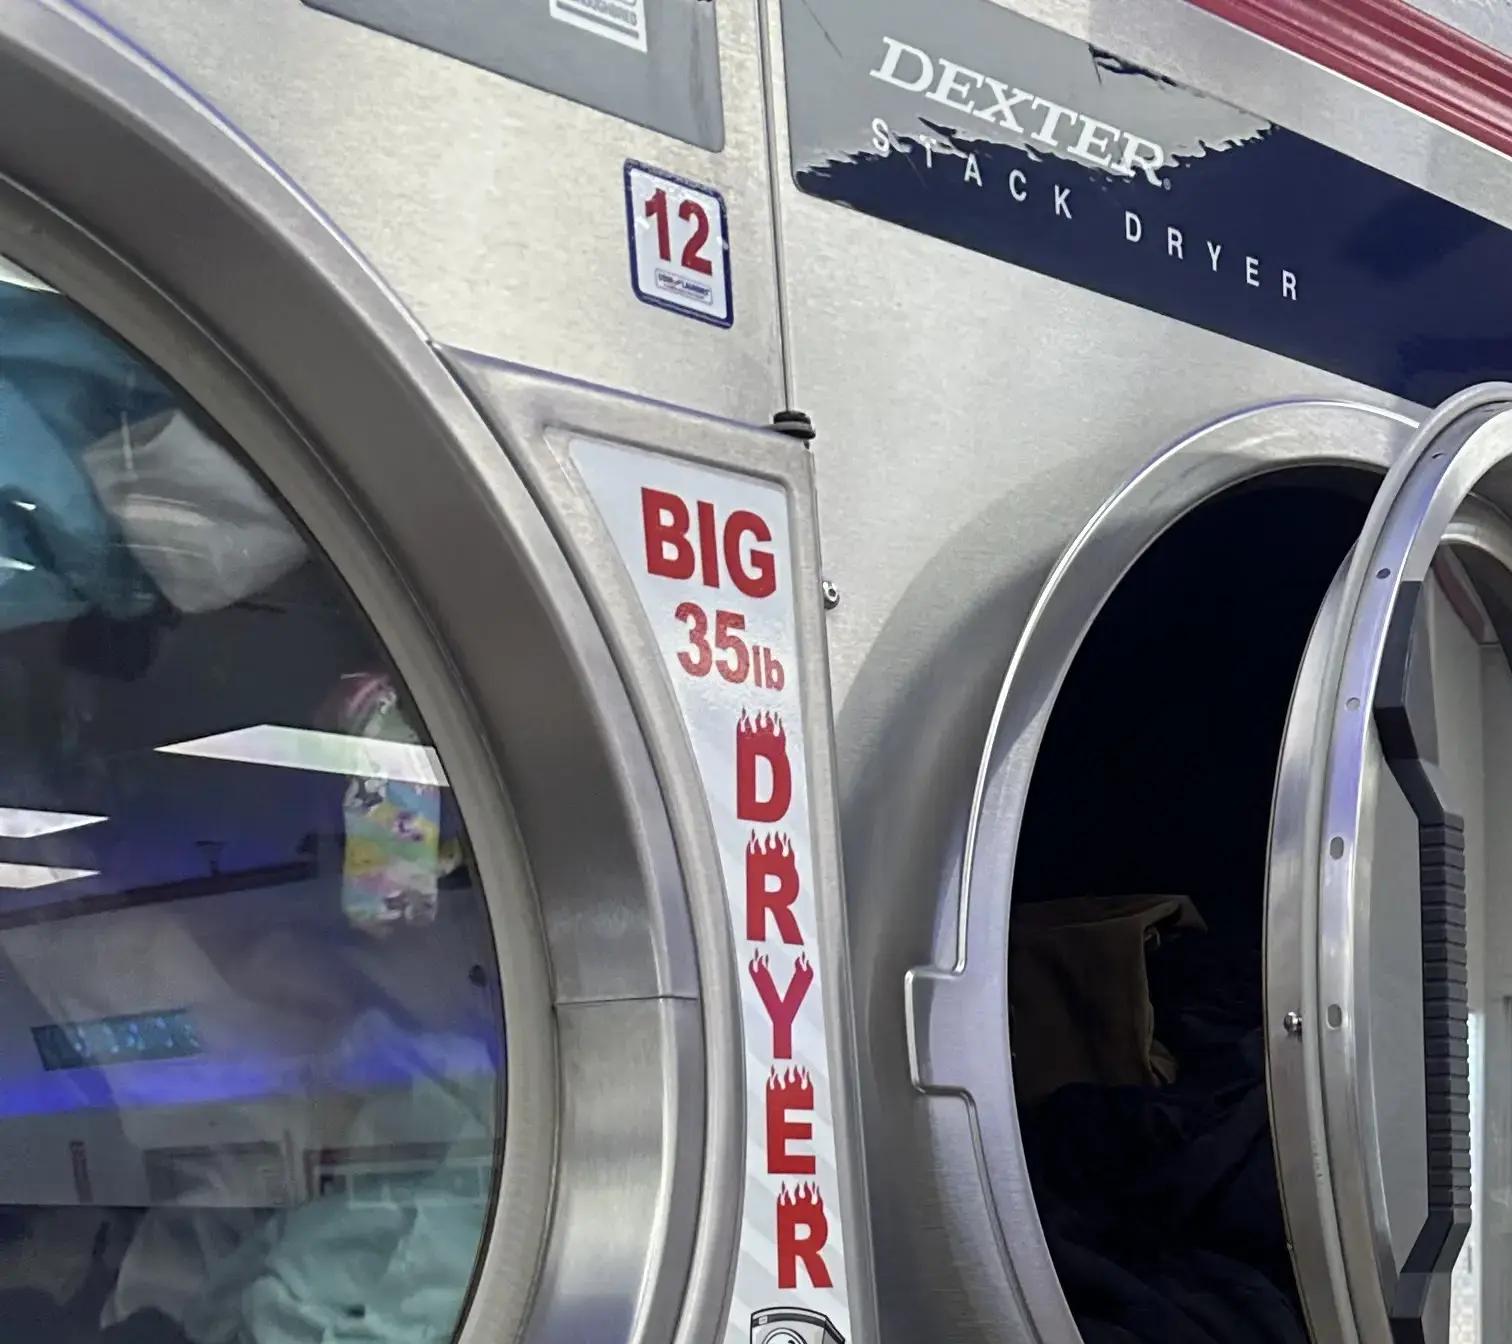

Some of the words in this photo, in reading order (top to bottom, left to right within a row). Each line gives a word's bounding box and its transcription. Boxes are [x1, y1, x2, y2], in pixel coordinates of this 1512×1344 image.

[869, 36, 1166, 188] DEXTER
[645, 188, 713, 276] 12
[871, 117, 1073, 219] STACK
[1125, 211, 1297, 300] DRYER
[641, 487, 777, 600] BIG
[674, 602, 785, 692] 35lb
[737, 707, 833, 1289] DRYER
